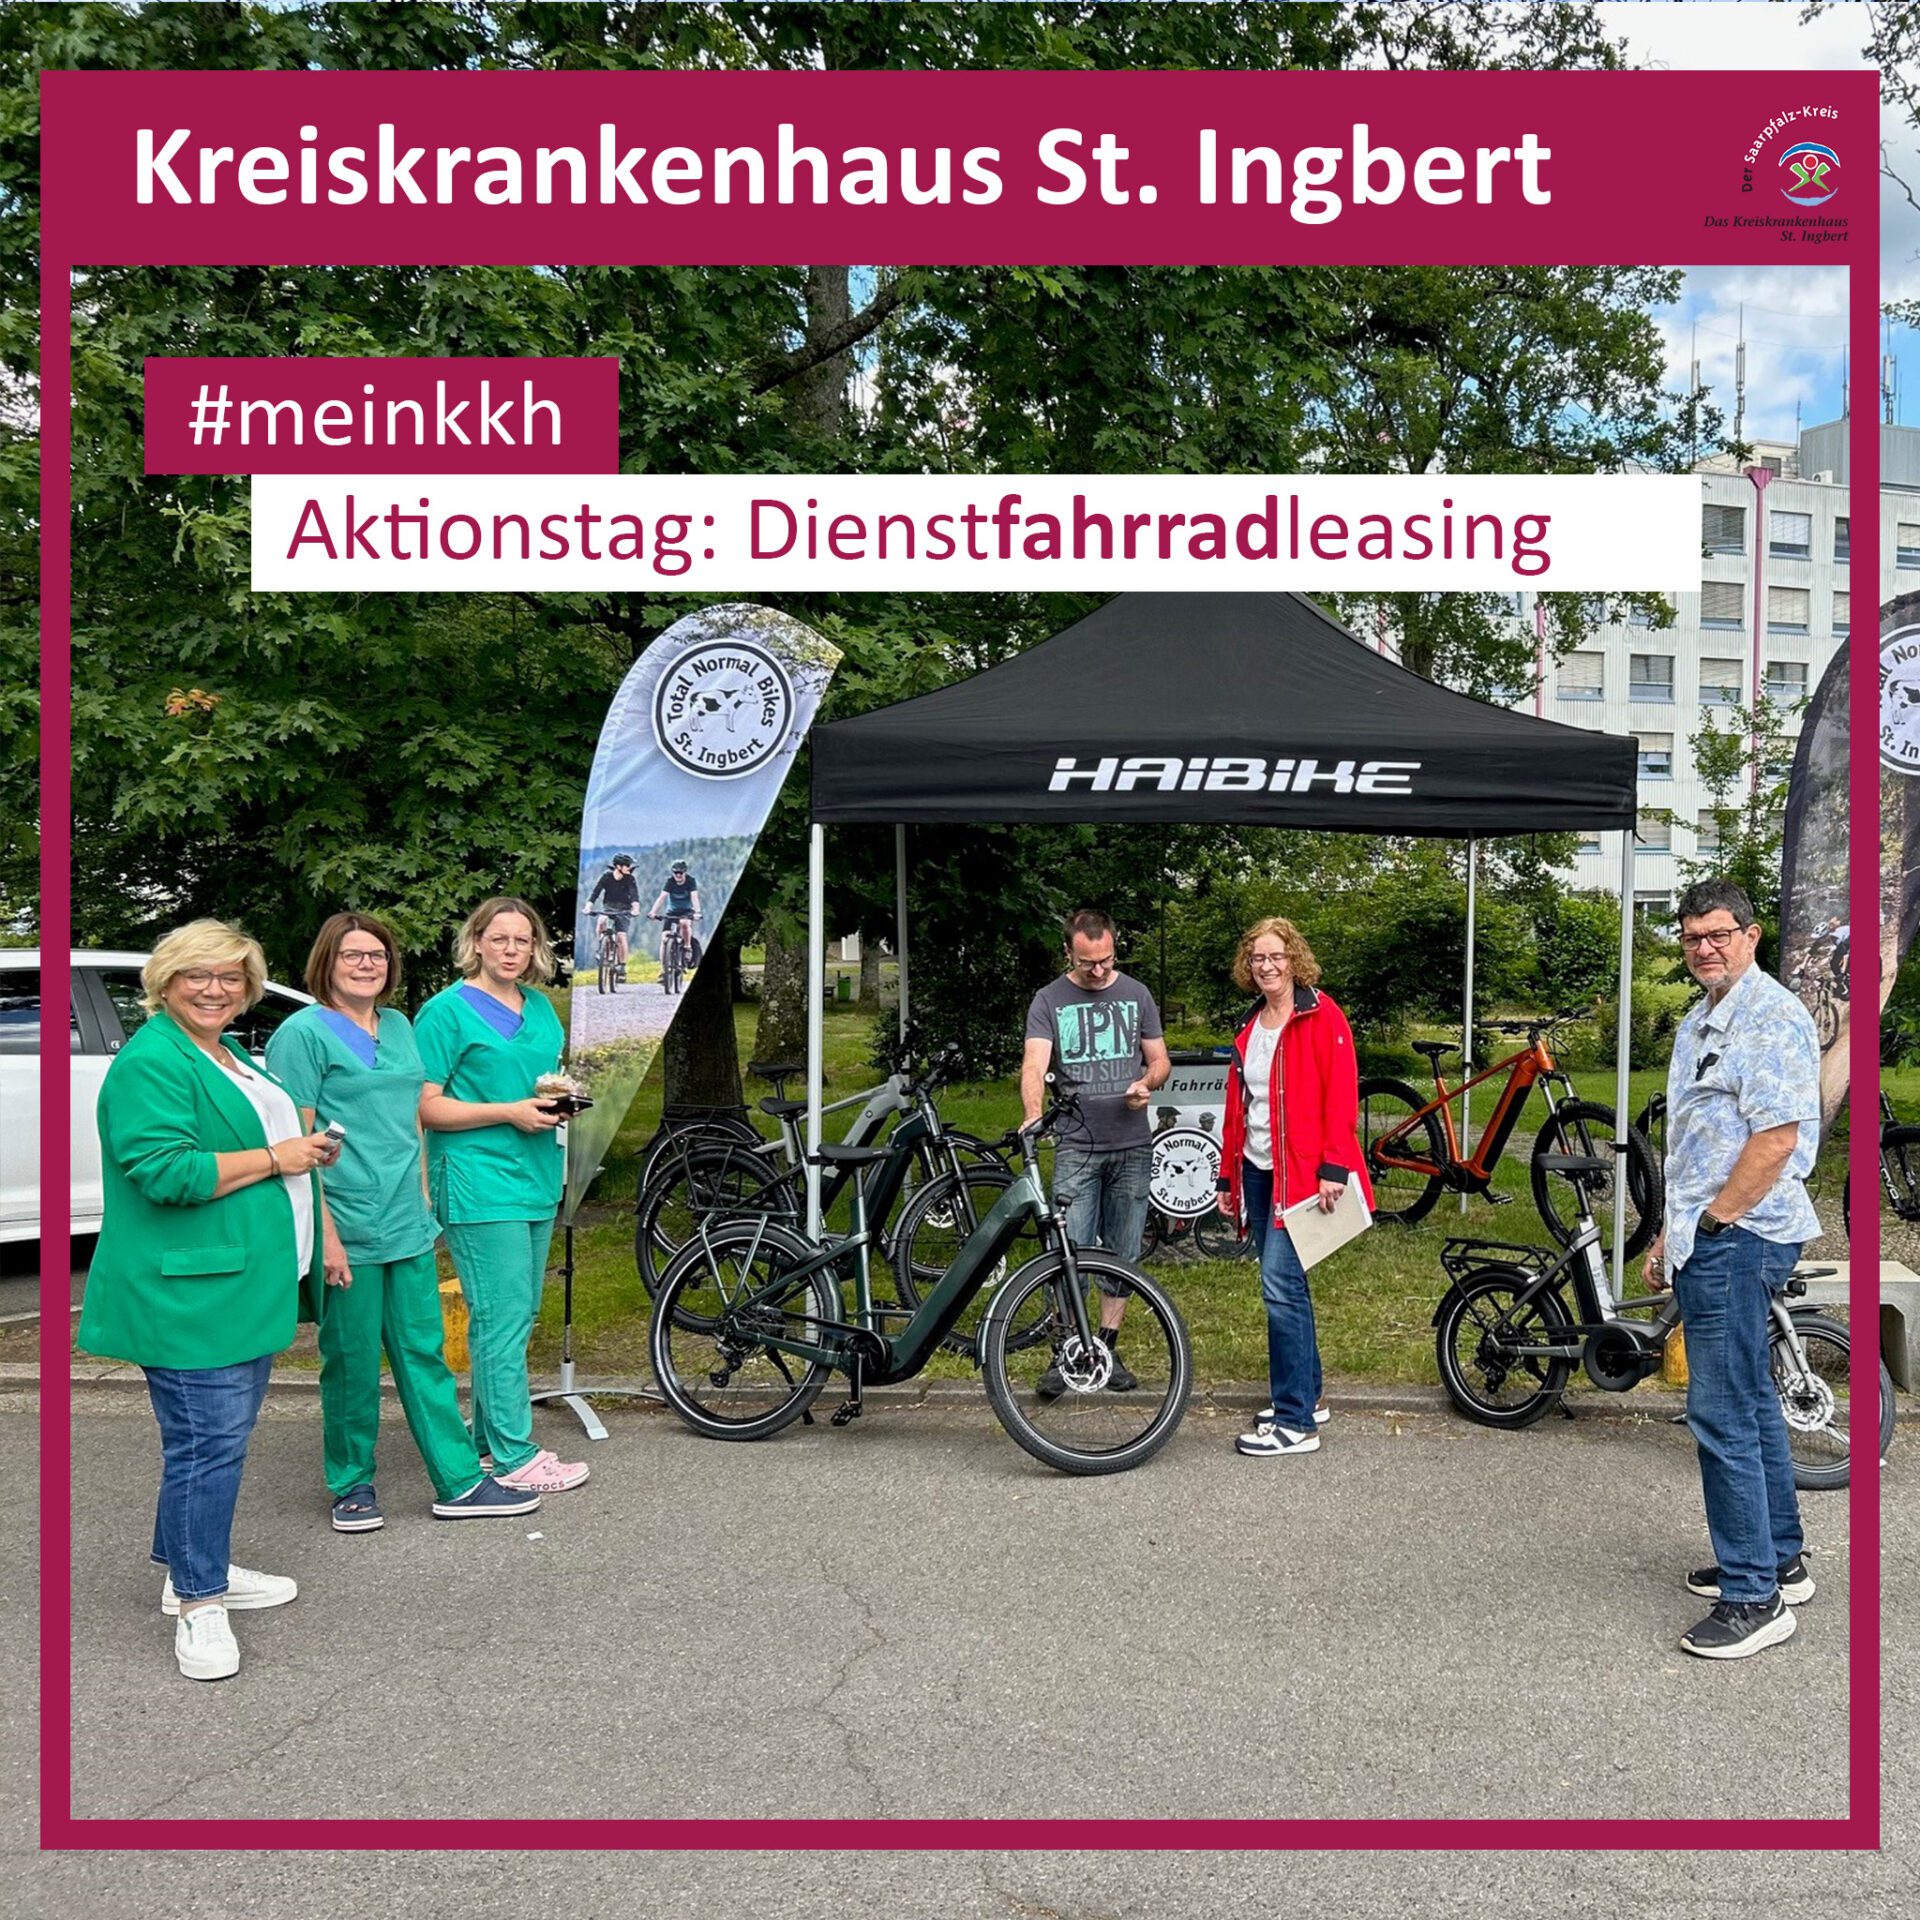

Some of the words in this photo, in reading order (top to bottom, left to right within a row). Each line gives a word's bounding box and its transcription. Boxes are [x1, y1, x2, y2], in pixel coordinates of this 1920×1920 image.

[667, 675, 694, 724] Total
[692, 656, 760, 678] Normal
[756, 676, 780, 728] Bikes
[674, 731, 693, 756] St.
[697, 737, 764, 768] Ingbert
[1065, 1004, 1135, 1058] JPN
[1163, 1138, 1207, 1152] Normal
[1157, 1187, 1170, 1203] St.
[1172, 1190, 1213, 1210] Ingbert
[529, 1481, 566, 1491] crocs
